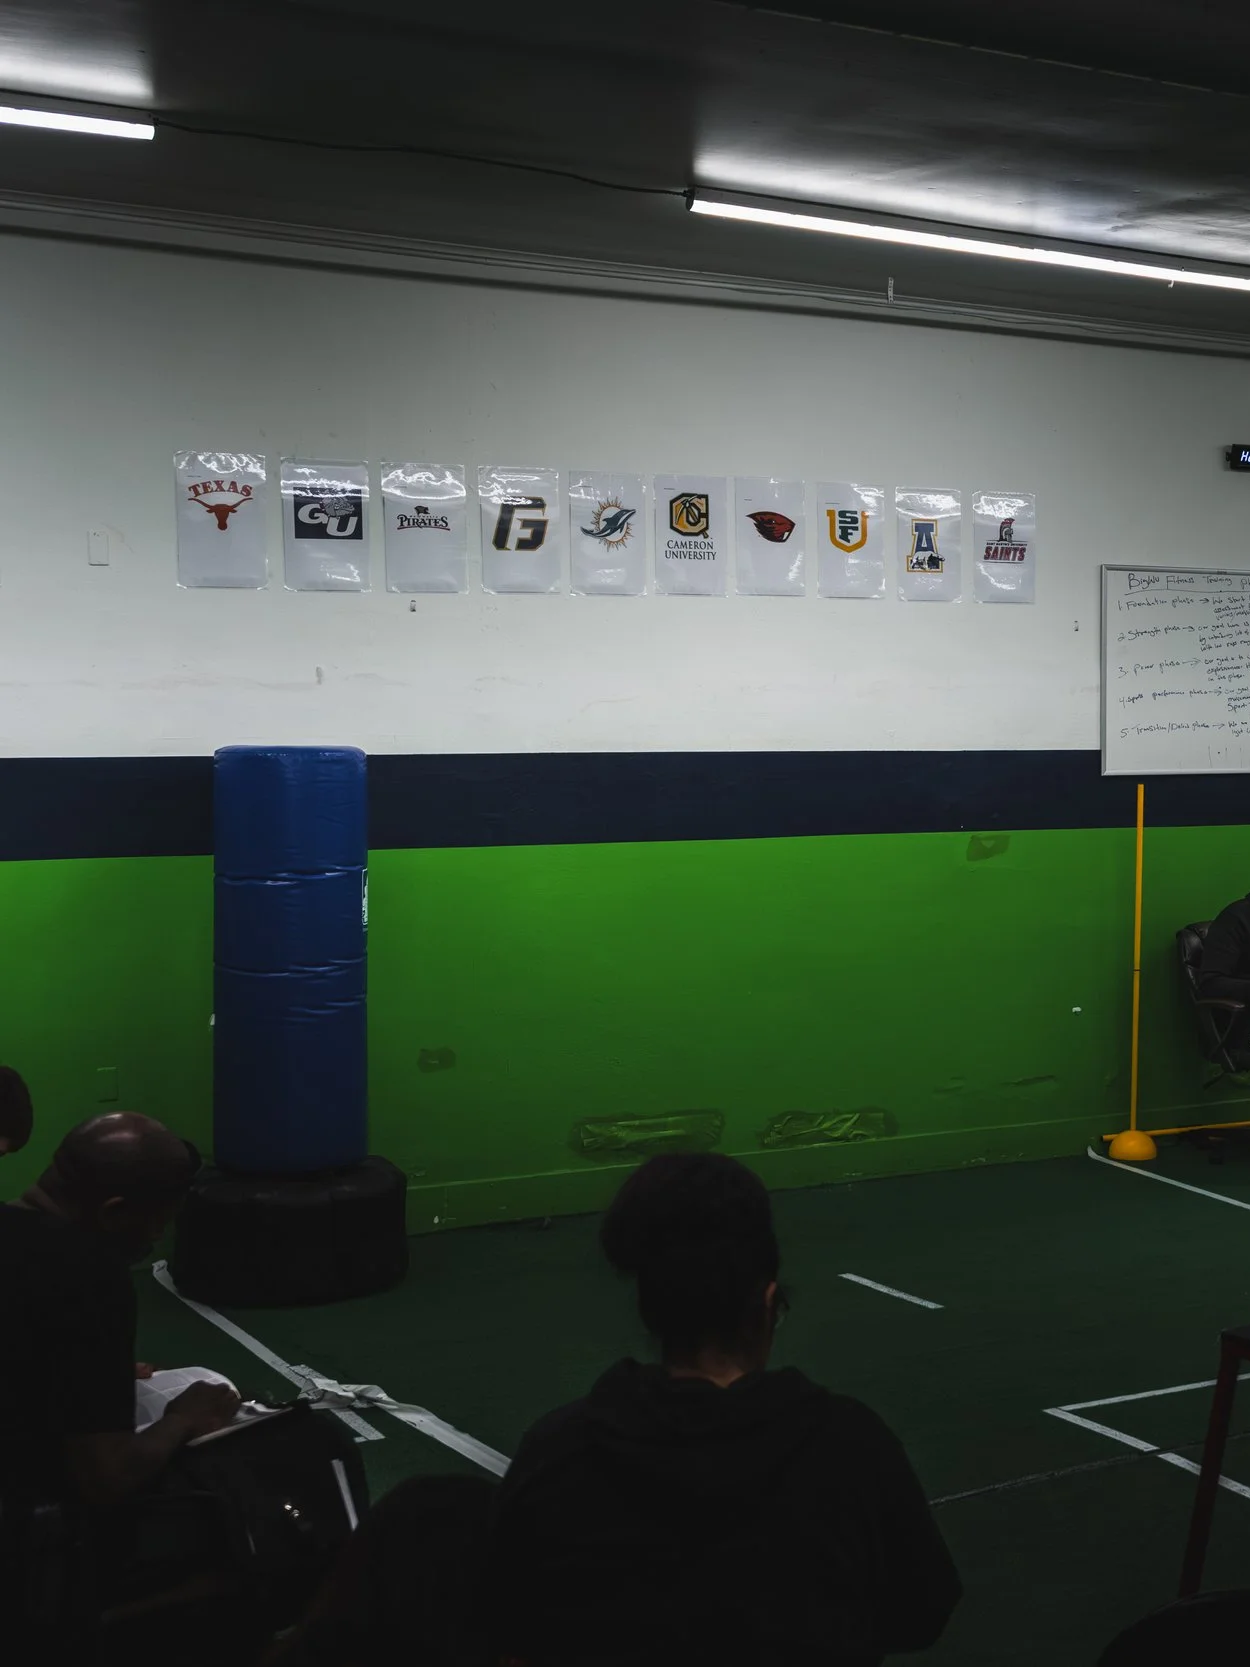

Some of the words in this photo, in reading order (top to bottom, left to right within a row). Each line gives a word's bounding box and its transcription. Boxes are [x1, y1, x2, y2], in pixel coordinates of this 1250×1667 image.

[188, 480, 253, 498] TEXAS
[297, 503, 358, 537] GU
[397, 514, 448, 528] PIRATES
[667, 540, 714, 550] CAMERON
[665, 550, 717, 561] UNIVERSITY
[984, 546, 1026, 561] SAINTS
[1166, 576, 1195, 590] Fitness
[1126, 598, 1167, 610] Foundation
[1127, 626, 1162, 641] Strength
